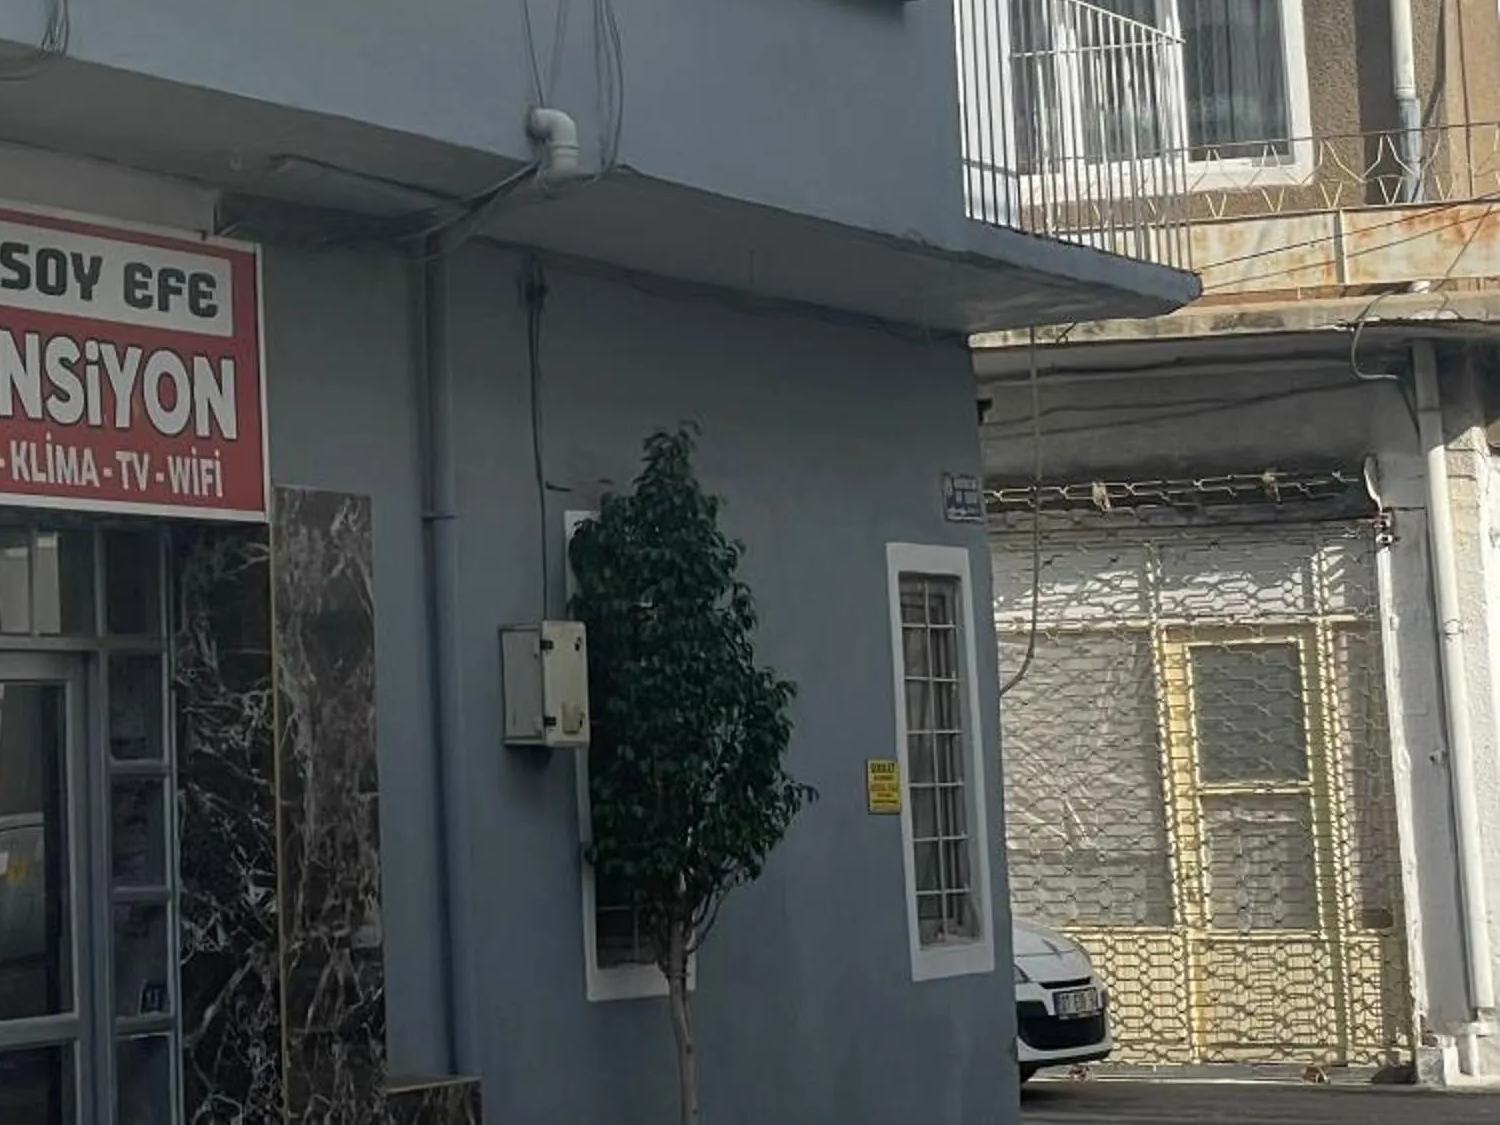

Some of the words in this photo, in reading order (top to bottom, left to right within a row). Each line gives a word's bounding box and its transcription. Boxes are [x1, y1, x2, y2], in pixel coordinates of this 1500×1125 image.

[123, 261, 218, 319] EFE
[9, 431, 100, 488] KLİMA
[115, 450, 150, 491] TV
